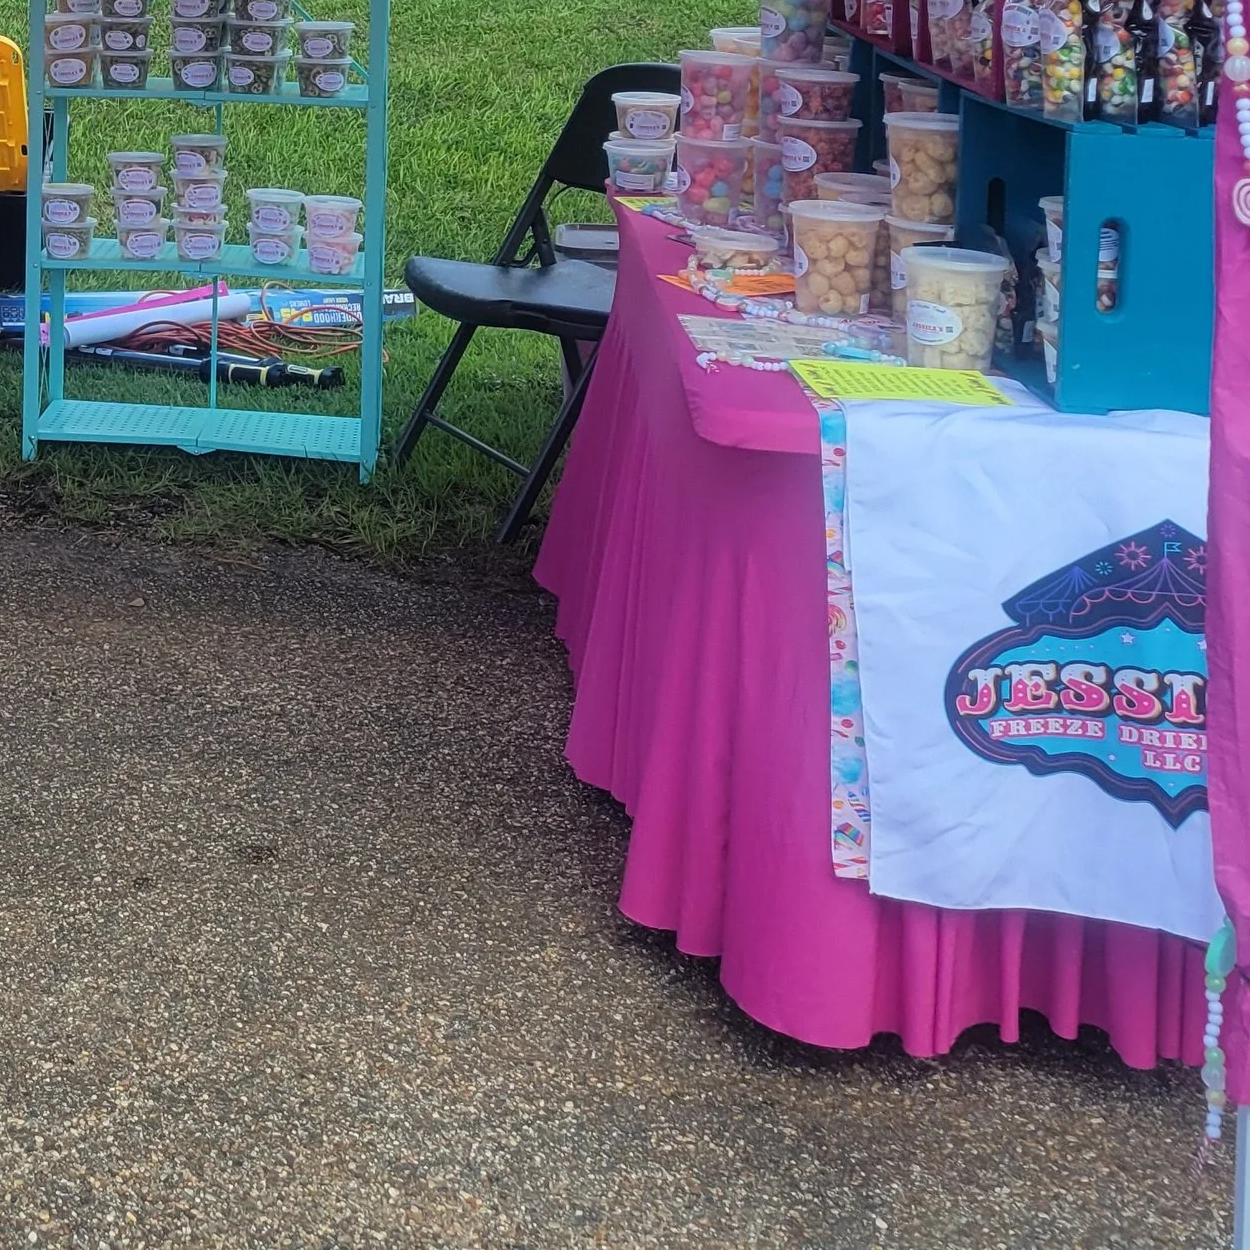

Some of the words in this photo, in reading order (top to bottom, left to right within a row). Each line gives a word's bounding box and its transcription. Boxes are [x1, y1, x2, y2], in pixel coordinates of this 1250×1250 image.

[382, 292, 414, 305] BRA
[956, 663, 1207, 724] JESSI
[990, 718, 1104, 738] FREEZE
[1143, 750, 1201, 772] LLC
